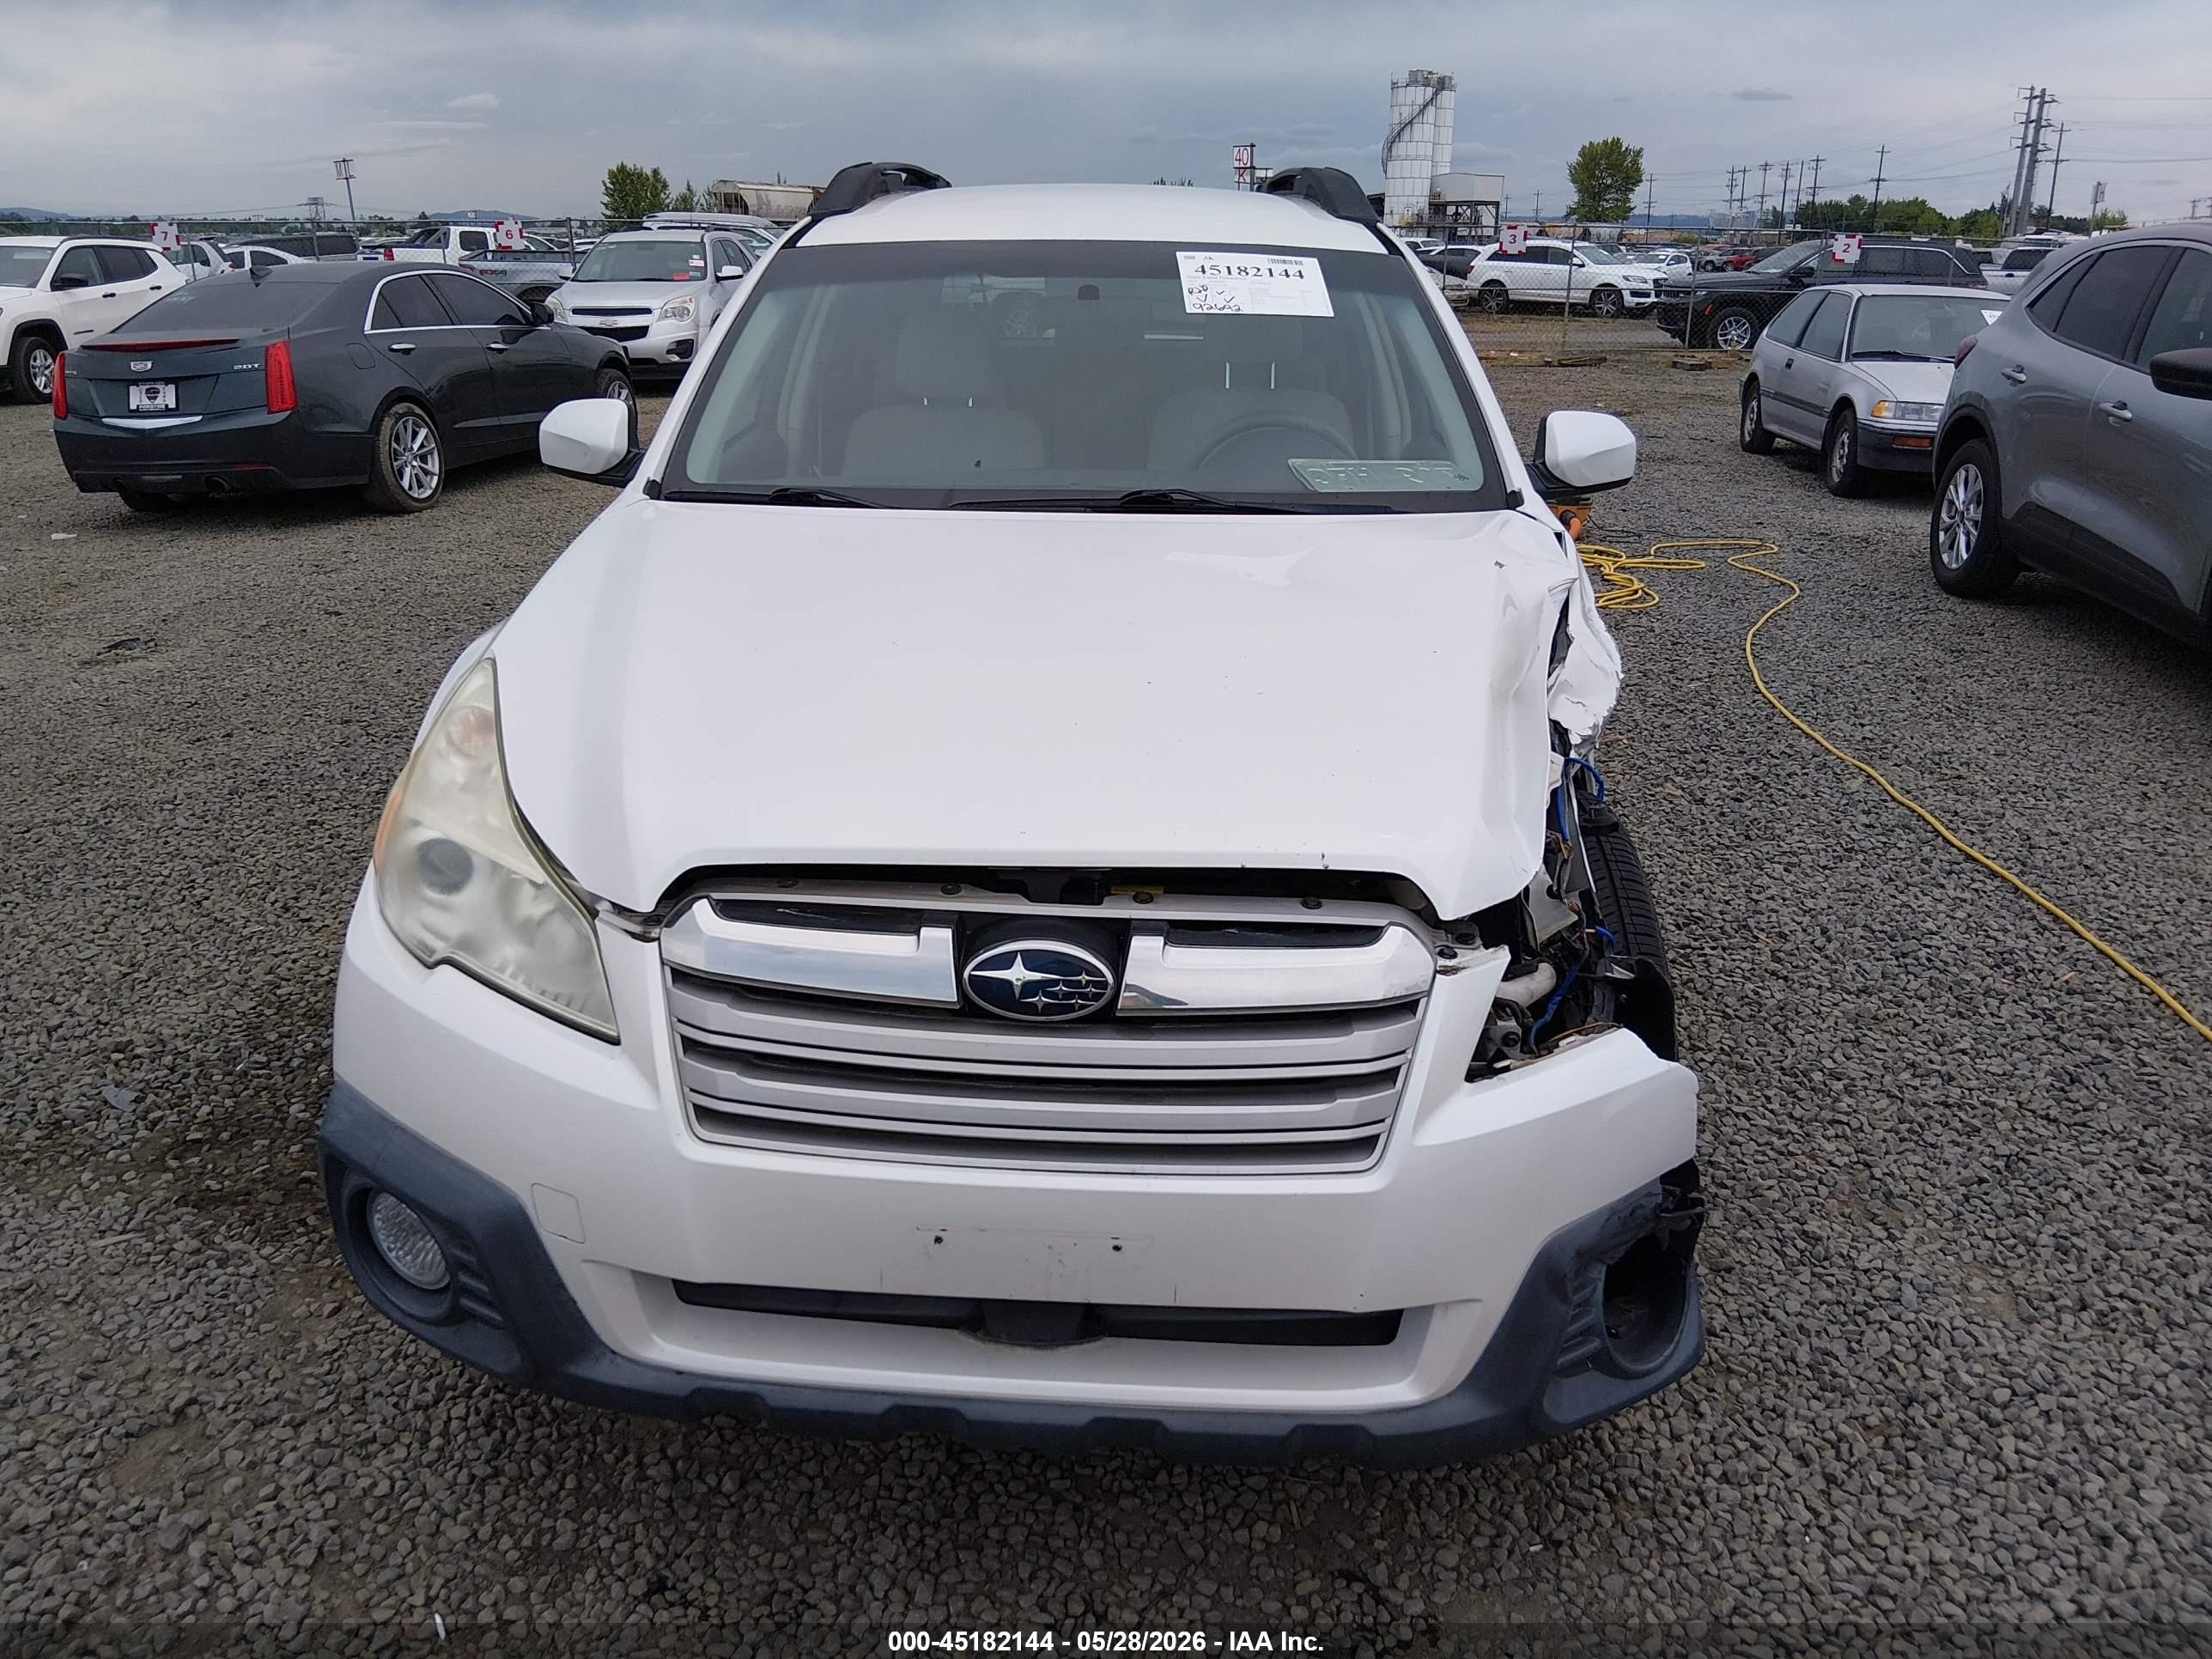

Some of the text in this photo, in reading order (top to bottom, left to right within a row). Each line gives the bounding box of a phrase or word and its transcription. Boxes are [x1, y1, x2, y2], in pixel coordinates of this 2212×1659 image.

[1235, 148, 1249, 166] 40
[161, 231, 168, 240] 7
[505, 229, 514, 240] 6
[1509, 234, 1517, 245] 3
[1842, 243, 1850, 253] 2
[1194, 264, 1305, 280] 45182144
